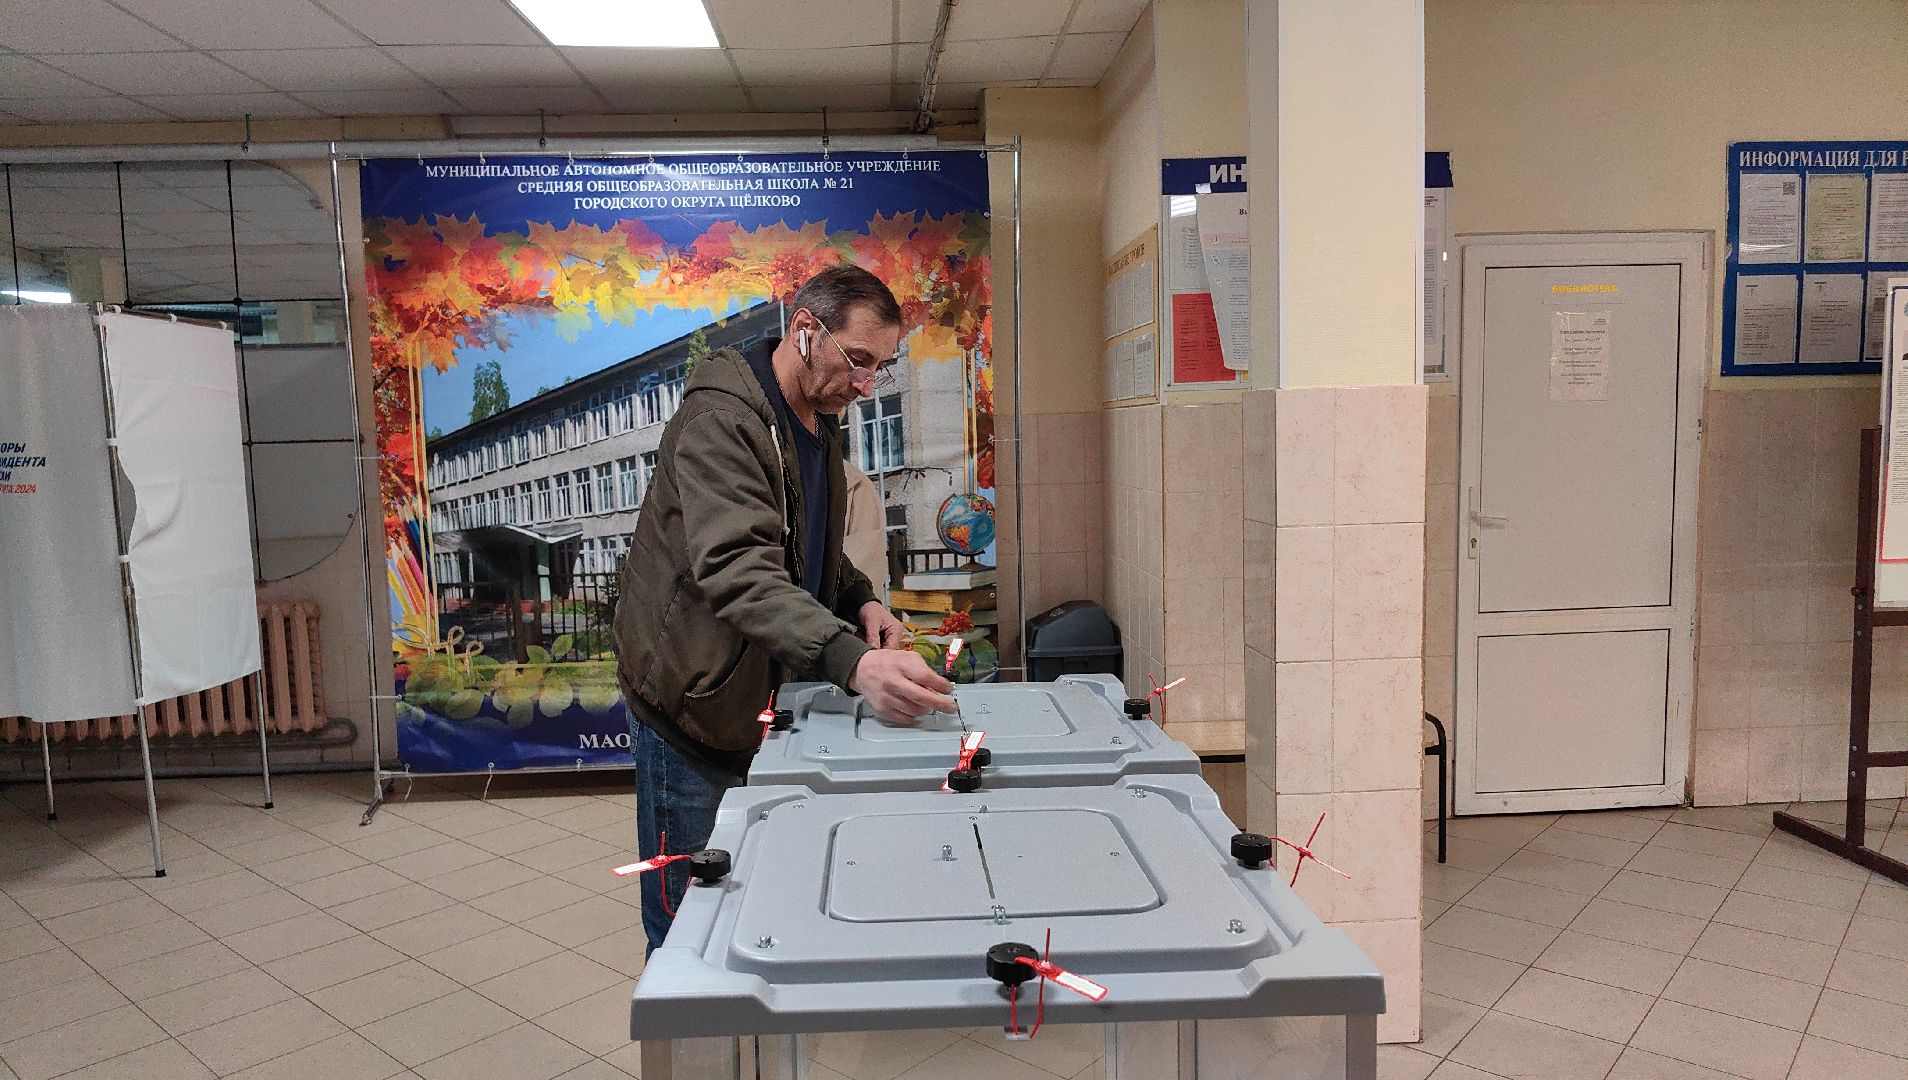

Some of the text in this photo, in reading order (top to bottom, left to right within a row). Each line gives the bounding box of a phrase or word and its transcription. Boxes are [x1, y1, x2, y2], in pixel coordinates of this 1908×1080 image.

[1739, 151, 1859, 169] ИНФОРМАЦИЯ
[1863, 151, 1898, 169] ДЛЯ
[426, 160, 941, 178] МУНИЦИПАЛЬНОЕ АВТОНОМНОЕ ОБЩЕОБРАЗОВАТЕЛЬНОЕ УЧРЕЖДЕНИЕ
[517, 177, 854, 194] СРЕДНЯЯ ОБЩЕОБРАЗОВАТЕЛЬНАЯ ШКОЛА № 21
[574, 193, 801, 210] ГОРОДСКОГО ОКРУГА ЩЁЛКОВО
[0, 442, 26, 453] ОРЫ
[14, 483, 37, 494] 2024
